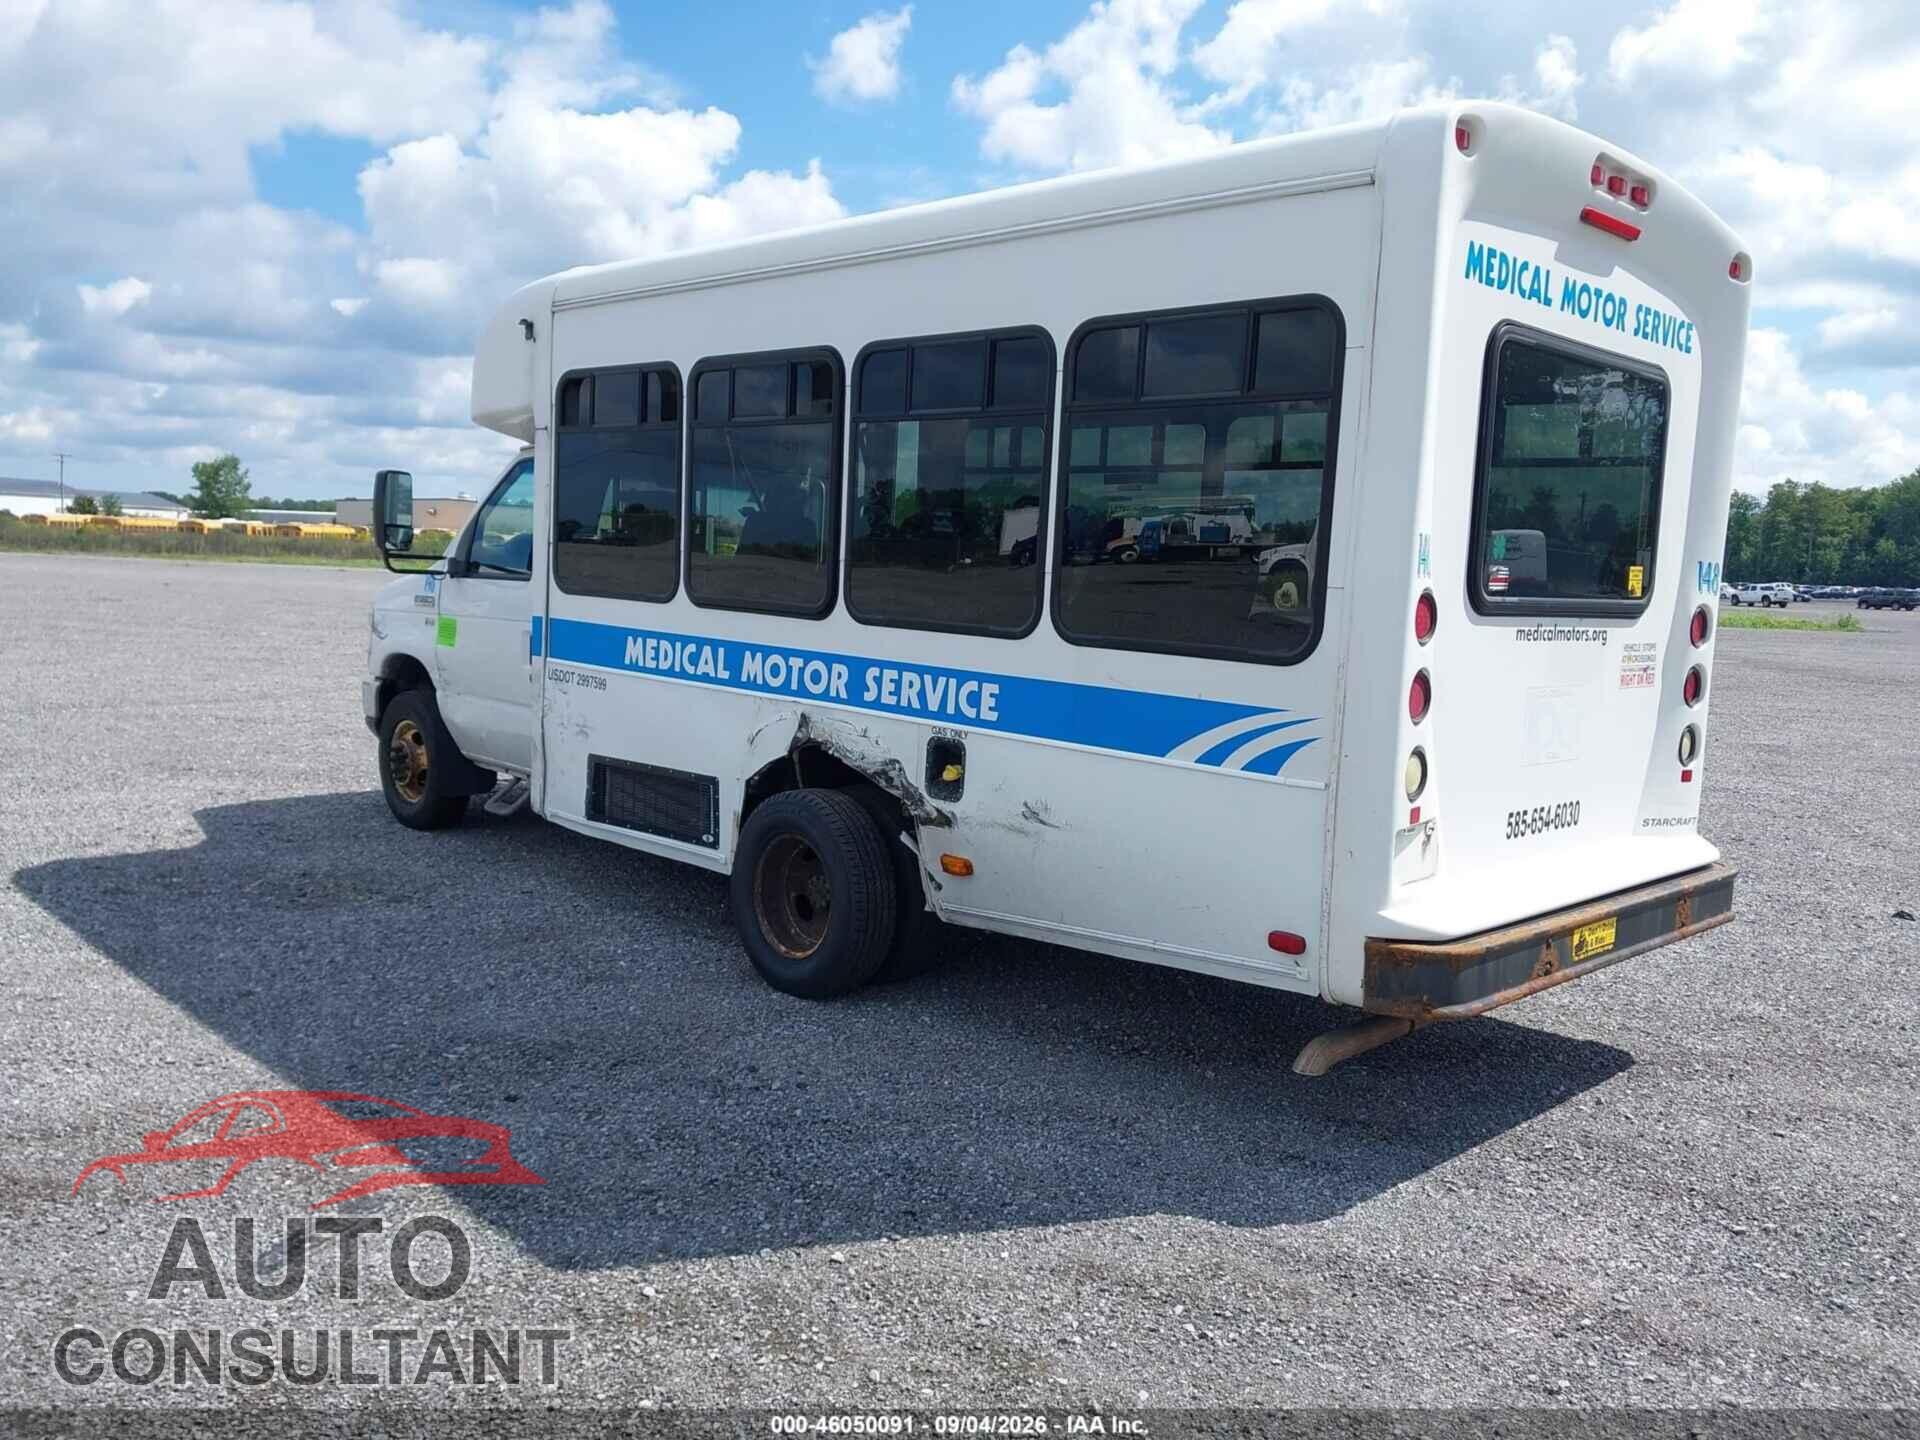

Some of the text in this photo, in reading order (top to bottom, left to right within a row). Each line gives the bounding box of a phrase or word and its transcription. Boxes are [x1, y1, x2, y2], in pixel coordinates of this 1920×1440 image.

[1464, 240, 1694, 354] MEDICAL MOTOR SERVICE
[1697, 560, 1720, 594] 148
[1515, 623, 1608, 646] medicalmotors.org
[547, 668, 575, 683] USDOT
[624, 635, 1000, 722] MEDICAL MOTOR SERVICE
[1506, 800, 1581, 840] 585-654-6030
[1641, 816, 1697, 828] STARCRAFT
